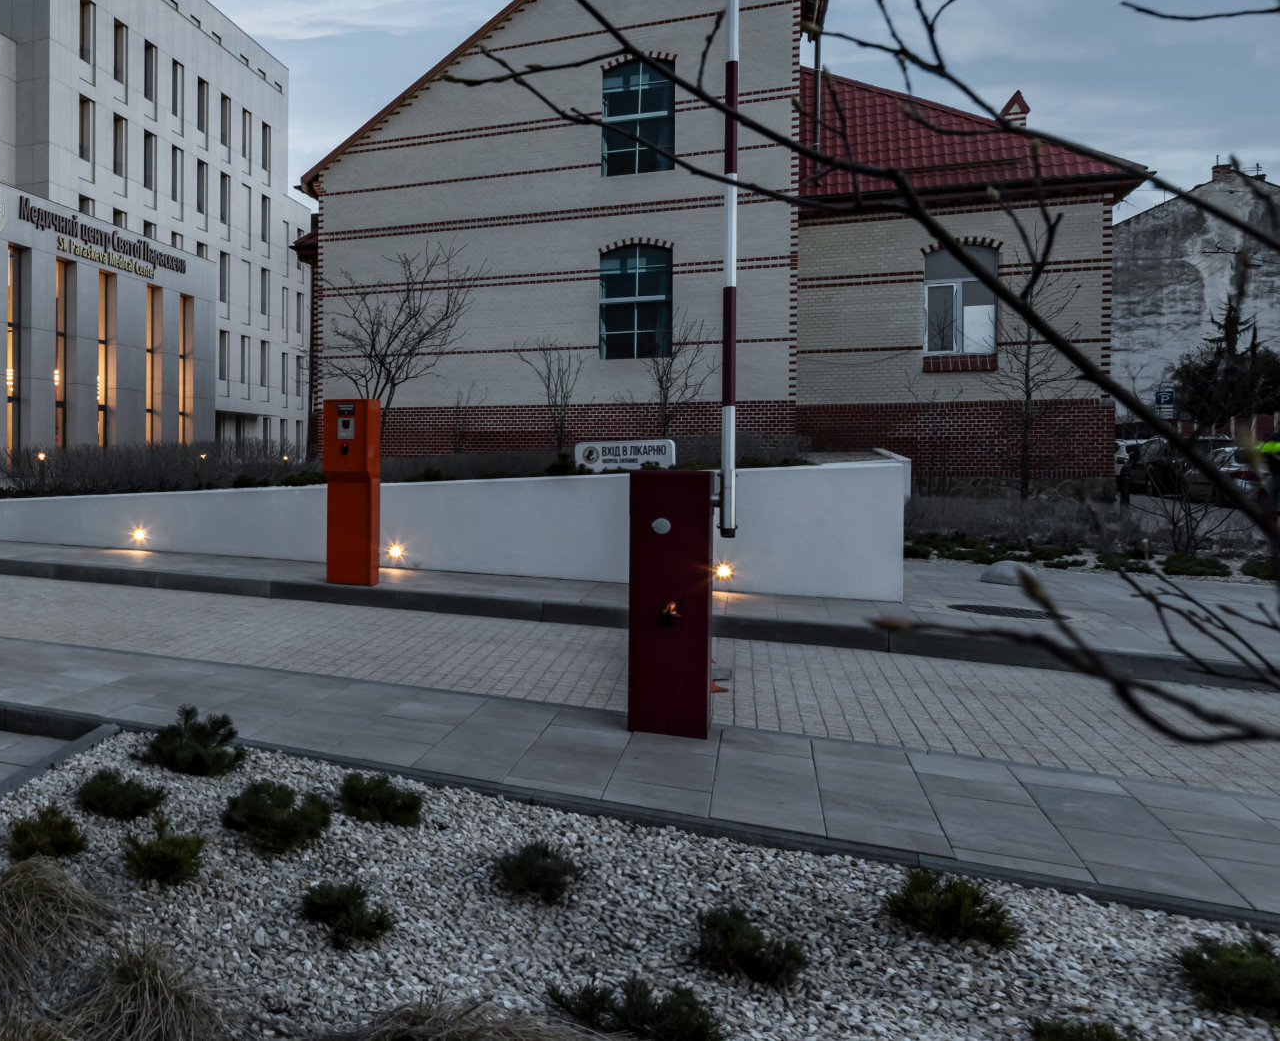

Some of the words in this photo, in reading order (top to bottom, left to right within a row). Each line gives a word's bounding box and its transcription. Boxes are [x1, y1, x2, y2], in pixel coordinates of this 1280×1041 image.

[19, 195, 79, 238] Медичний
[80, 223, 111, 254] центр
[112, 230, 142, 259] Святої
[142, 240, 186, 274] Параскеви
[69, 239, 107, 264] Paraskeva
[108, 252, 133, 272] Medical
[134, 260, 156, 279] Center
[1161, 395, 1170, 404] P
[601, 446, 621, 457] ВХІД
[622, 446, 628, 457] В
[629, 445, 667, 456] ЛІКАРНЮ
